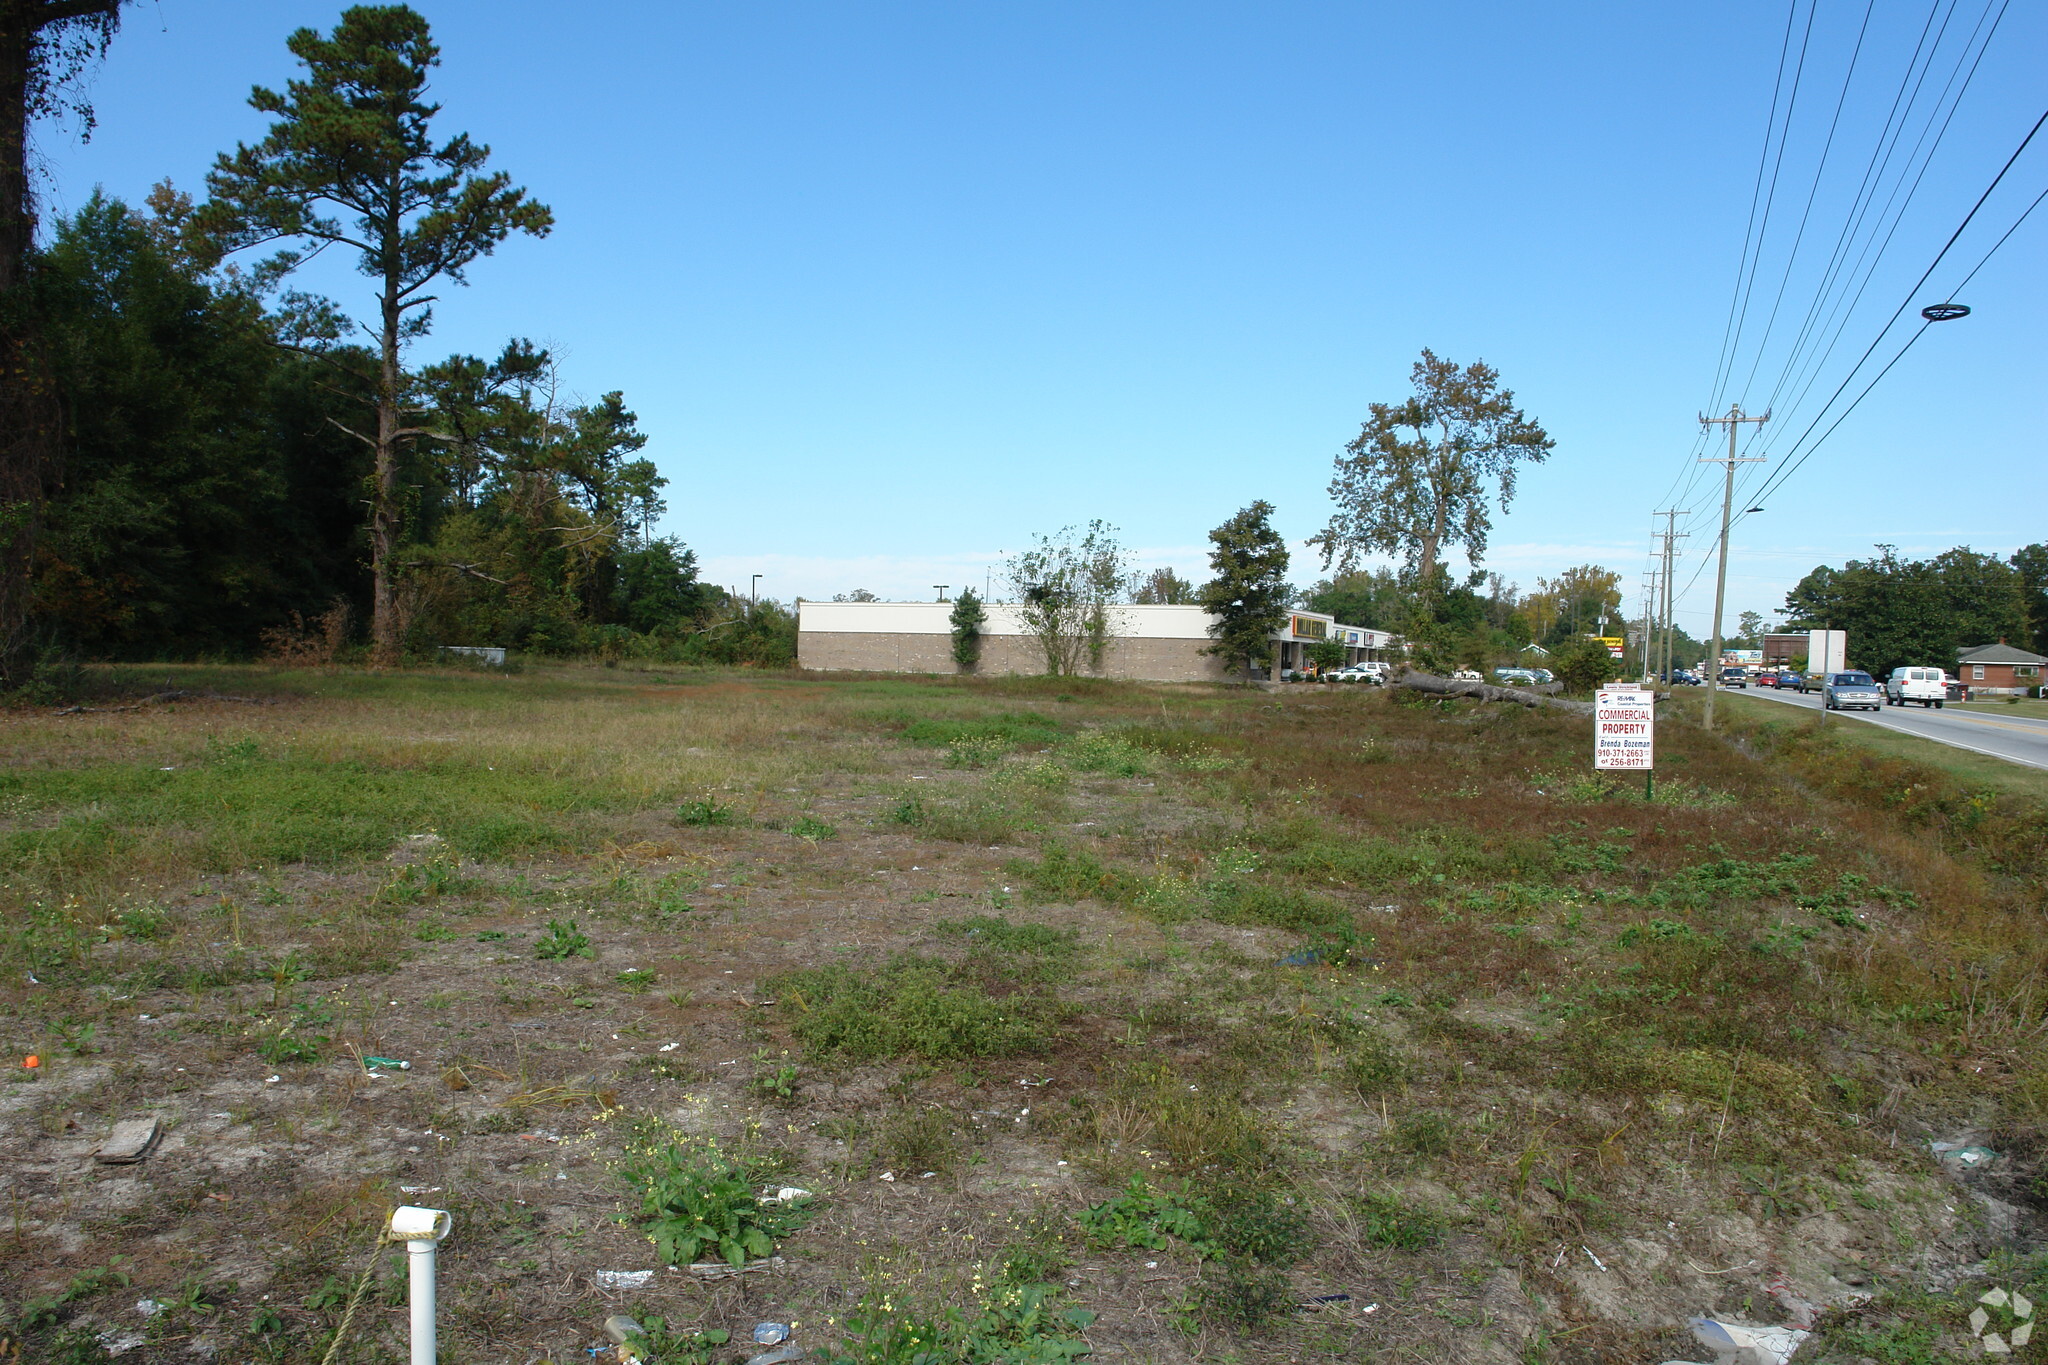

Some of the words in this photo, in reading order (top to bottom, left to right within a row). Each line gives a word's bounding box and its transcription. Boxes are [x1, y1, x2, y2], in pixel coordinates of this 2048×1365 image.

[1599, 710, 1650, 720] COMMERCIAL
[1602, 724, 1645, 734] PROPERTY
[1600, 739, 1621, 747] Brenda
[1623, 739, 1650, 747] Bozeman
[1610, 758, 1644, 766] 256-8171
